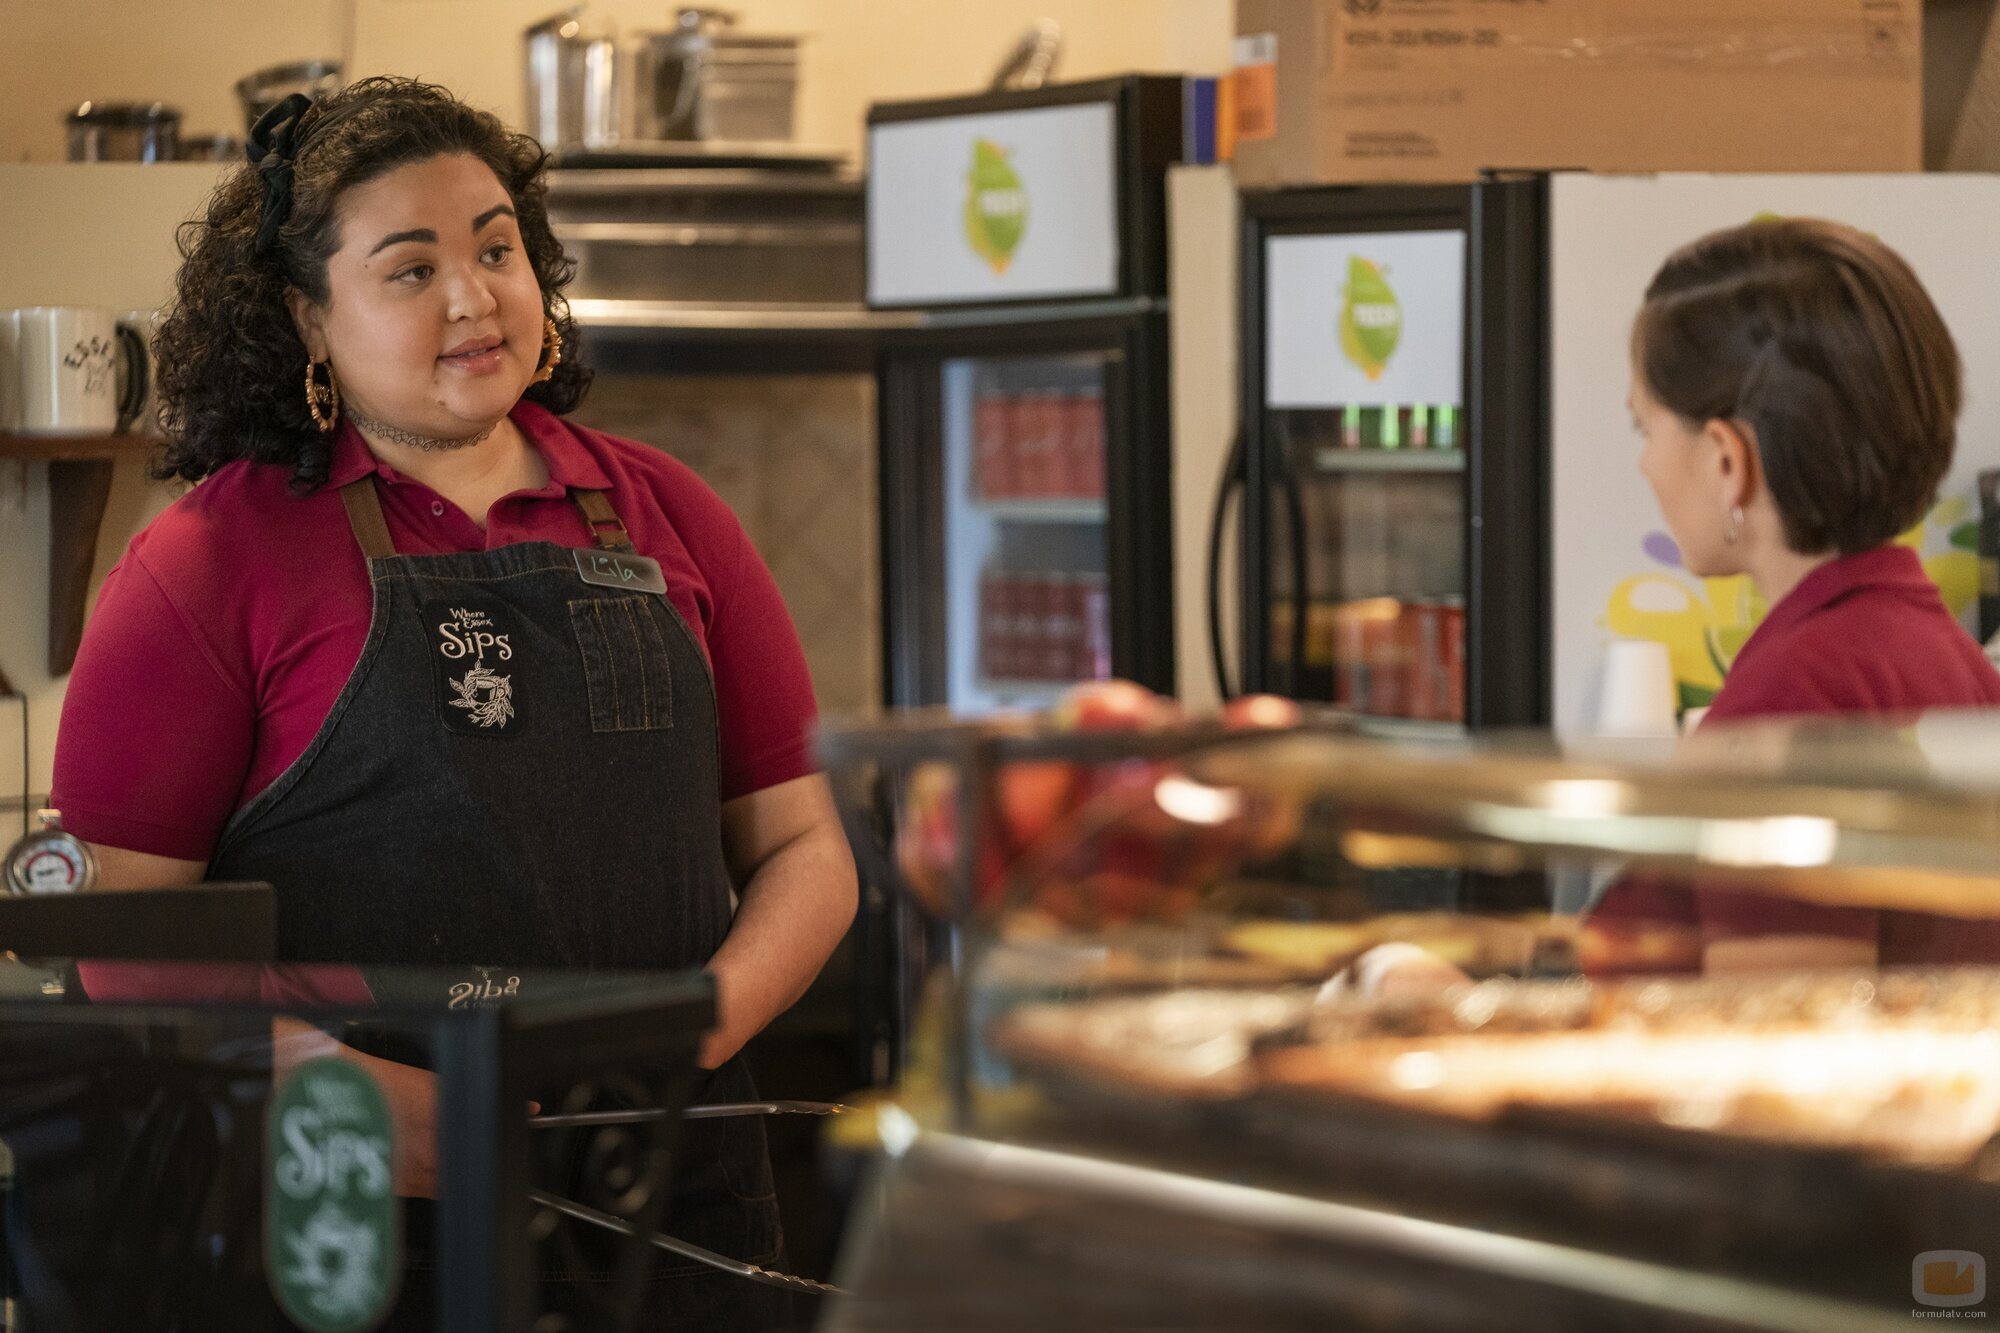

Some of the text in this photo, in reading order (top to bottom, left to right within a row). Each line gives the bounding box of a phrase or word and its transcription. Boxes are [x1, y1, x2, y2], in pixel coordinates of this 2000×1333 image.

[591, 556, 646, 582] Lila
[449, 607, 485, 619] Where
[463, 618, 494, 629] Essex
[438, 622, 513, 661] Sips
